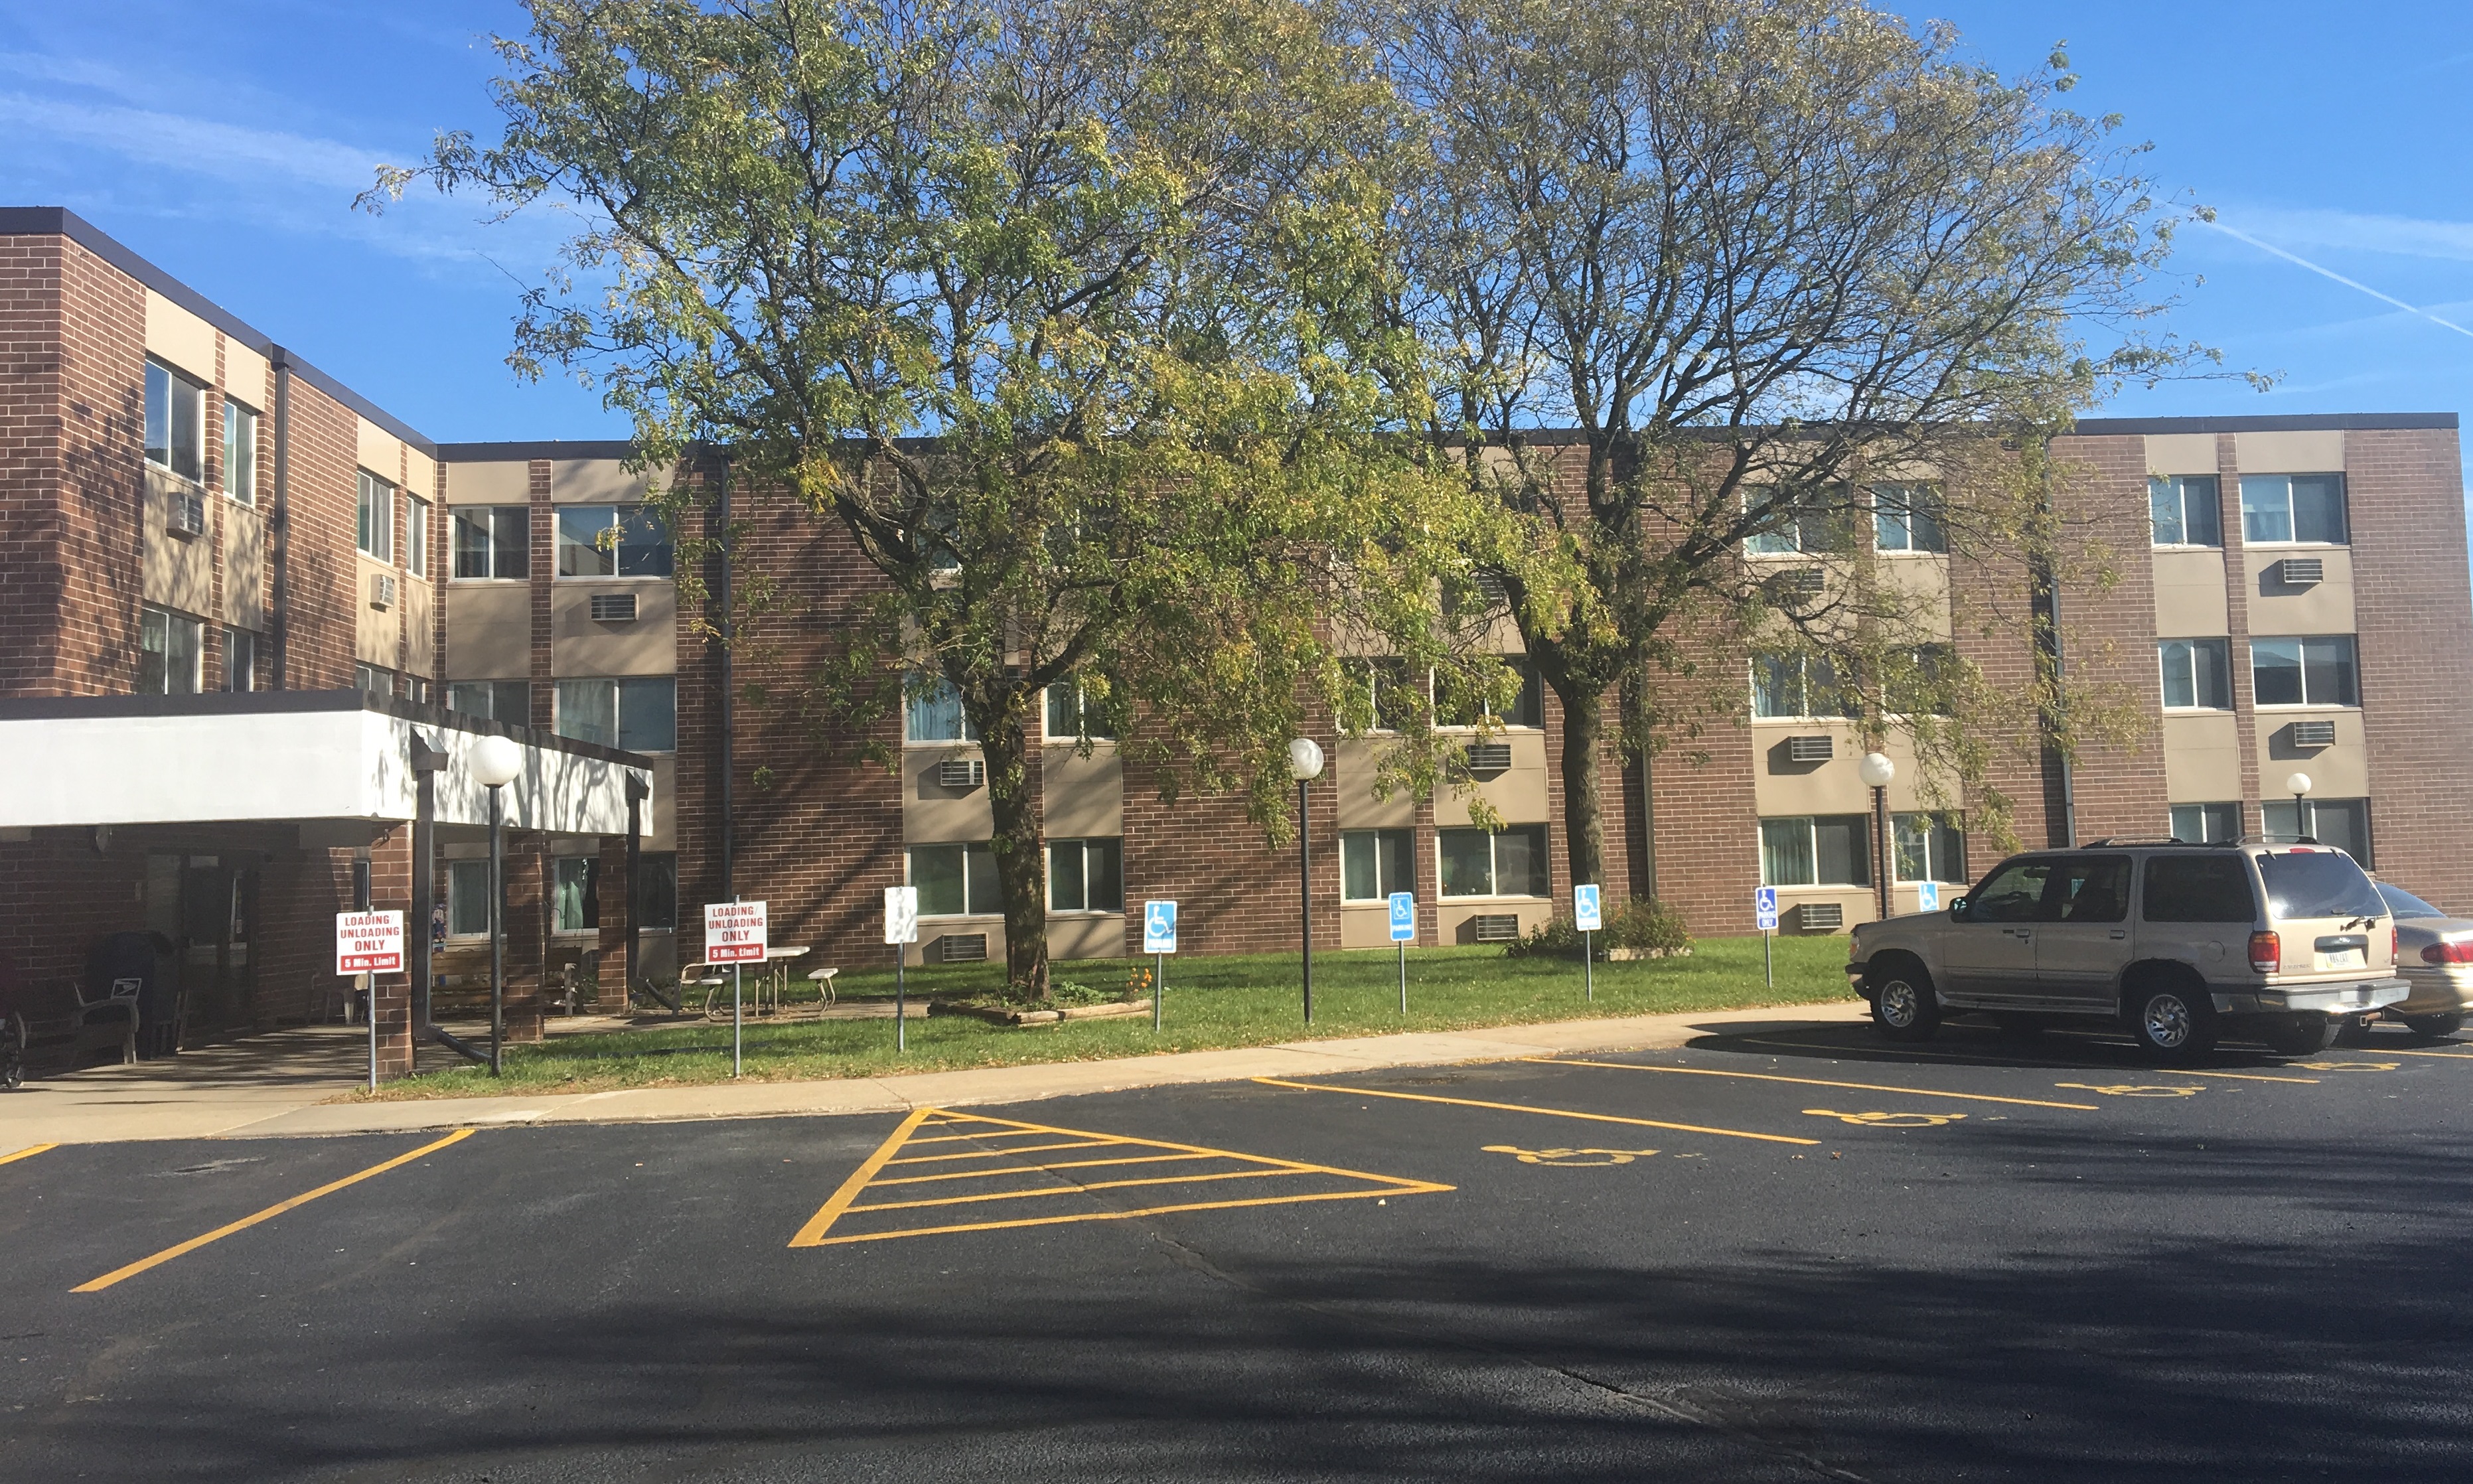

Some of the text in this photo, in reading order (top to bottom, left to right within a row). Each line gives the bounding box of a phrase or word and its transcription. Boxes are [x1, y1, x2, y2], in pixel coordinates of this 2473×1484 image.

[708, 917, 763, 930] UNLOADING
[340, 927, 400, 939] UNLOADING
[722, 930, 750, 942] ONLY
[354, 940, 385, 952] ONLY
[712, 946, 760, 958] 5 Min. Limit
[344, 956, 396, 968] 5 Min. Limit
